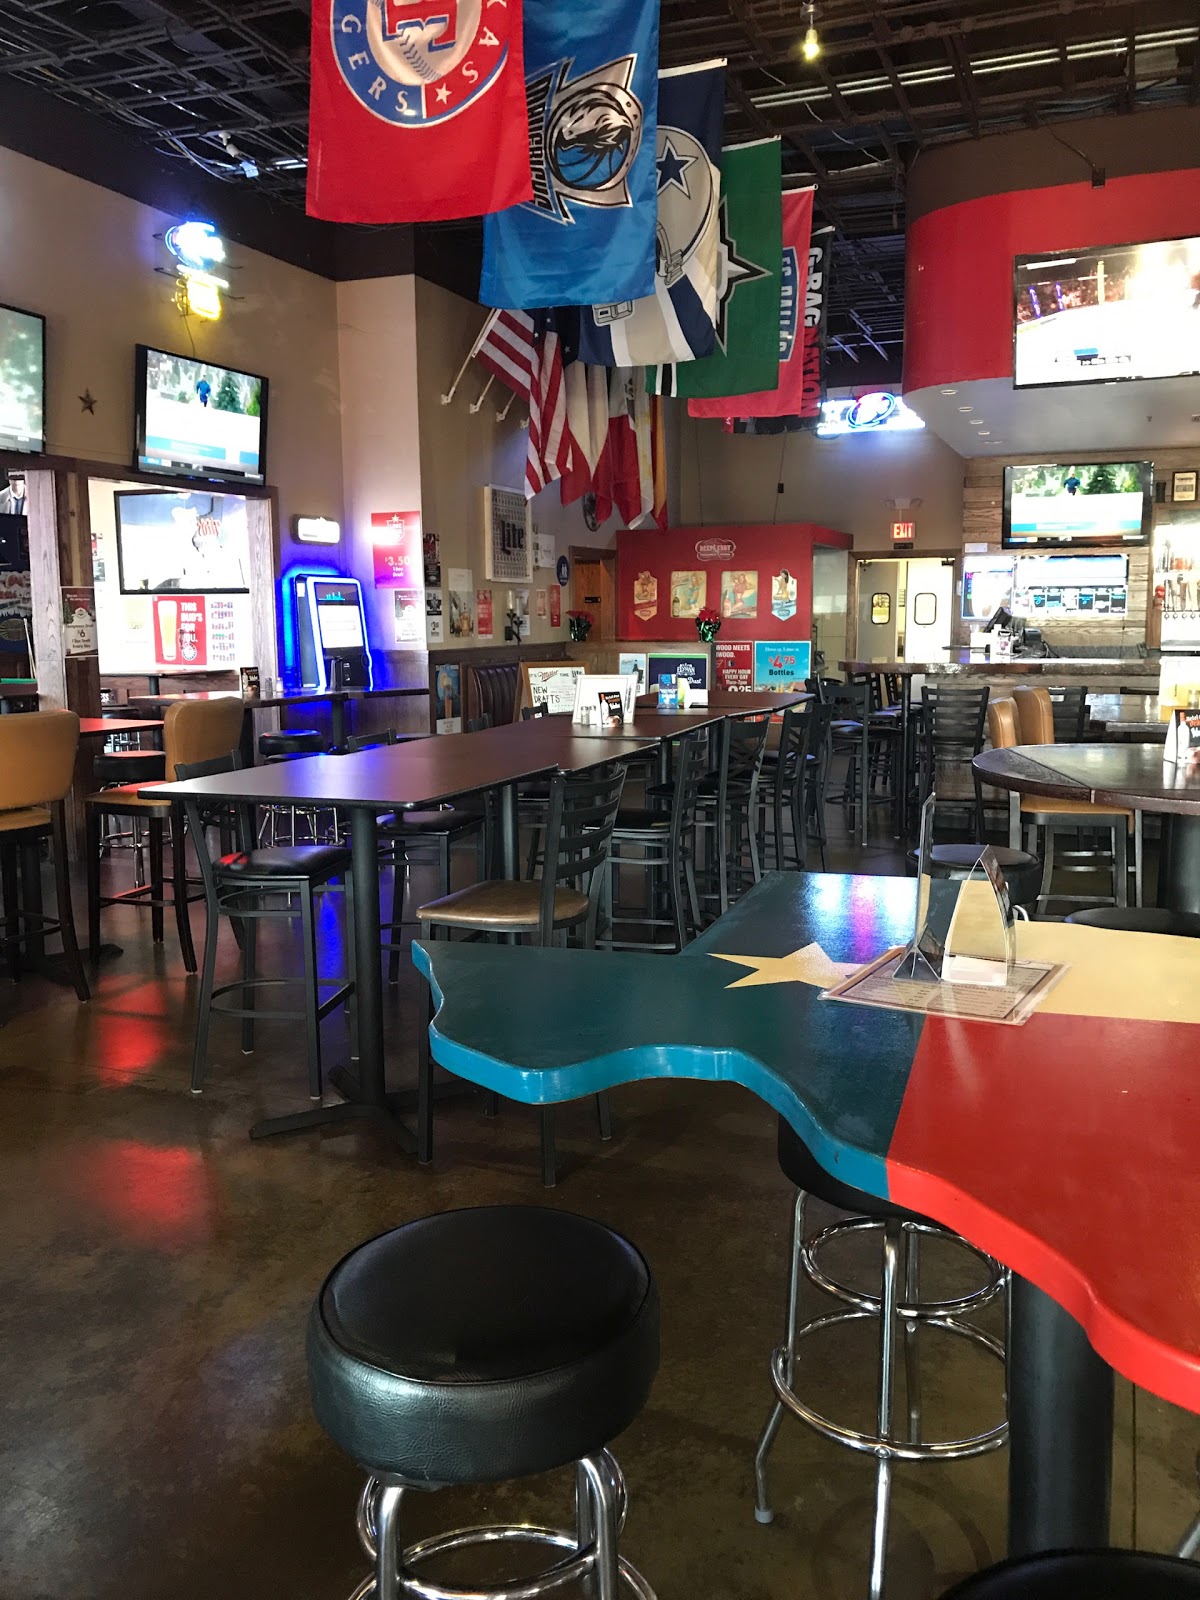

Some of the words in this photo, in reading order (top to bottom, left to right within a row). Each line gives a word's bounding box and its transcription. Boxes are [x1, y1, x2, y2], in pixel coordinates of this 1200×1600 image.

[893, 522, 913, 539] EXIT
[180, 602, 197, 612] THIS
[533, 686, 548, 694] NEW
[534, 694, 561, 704] DRAFTS
